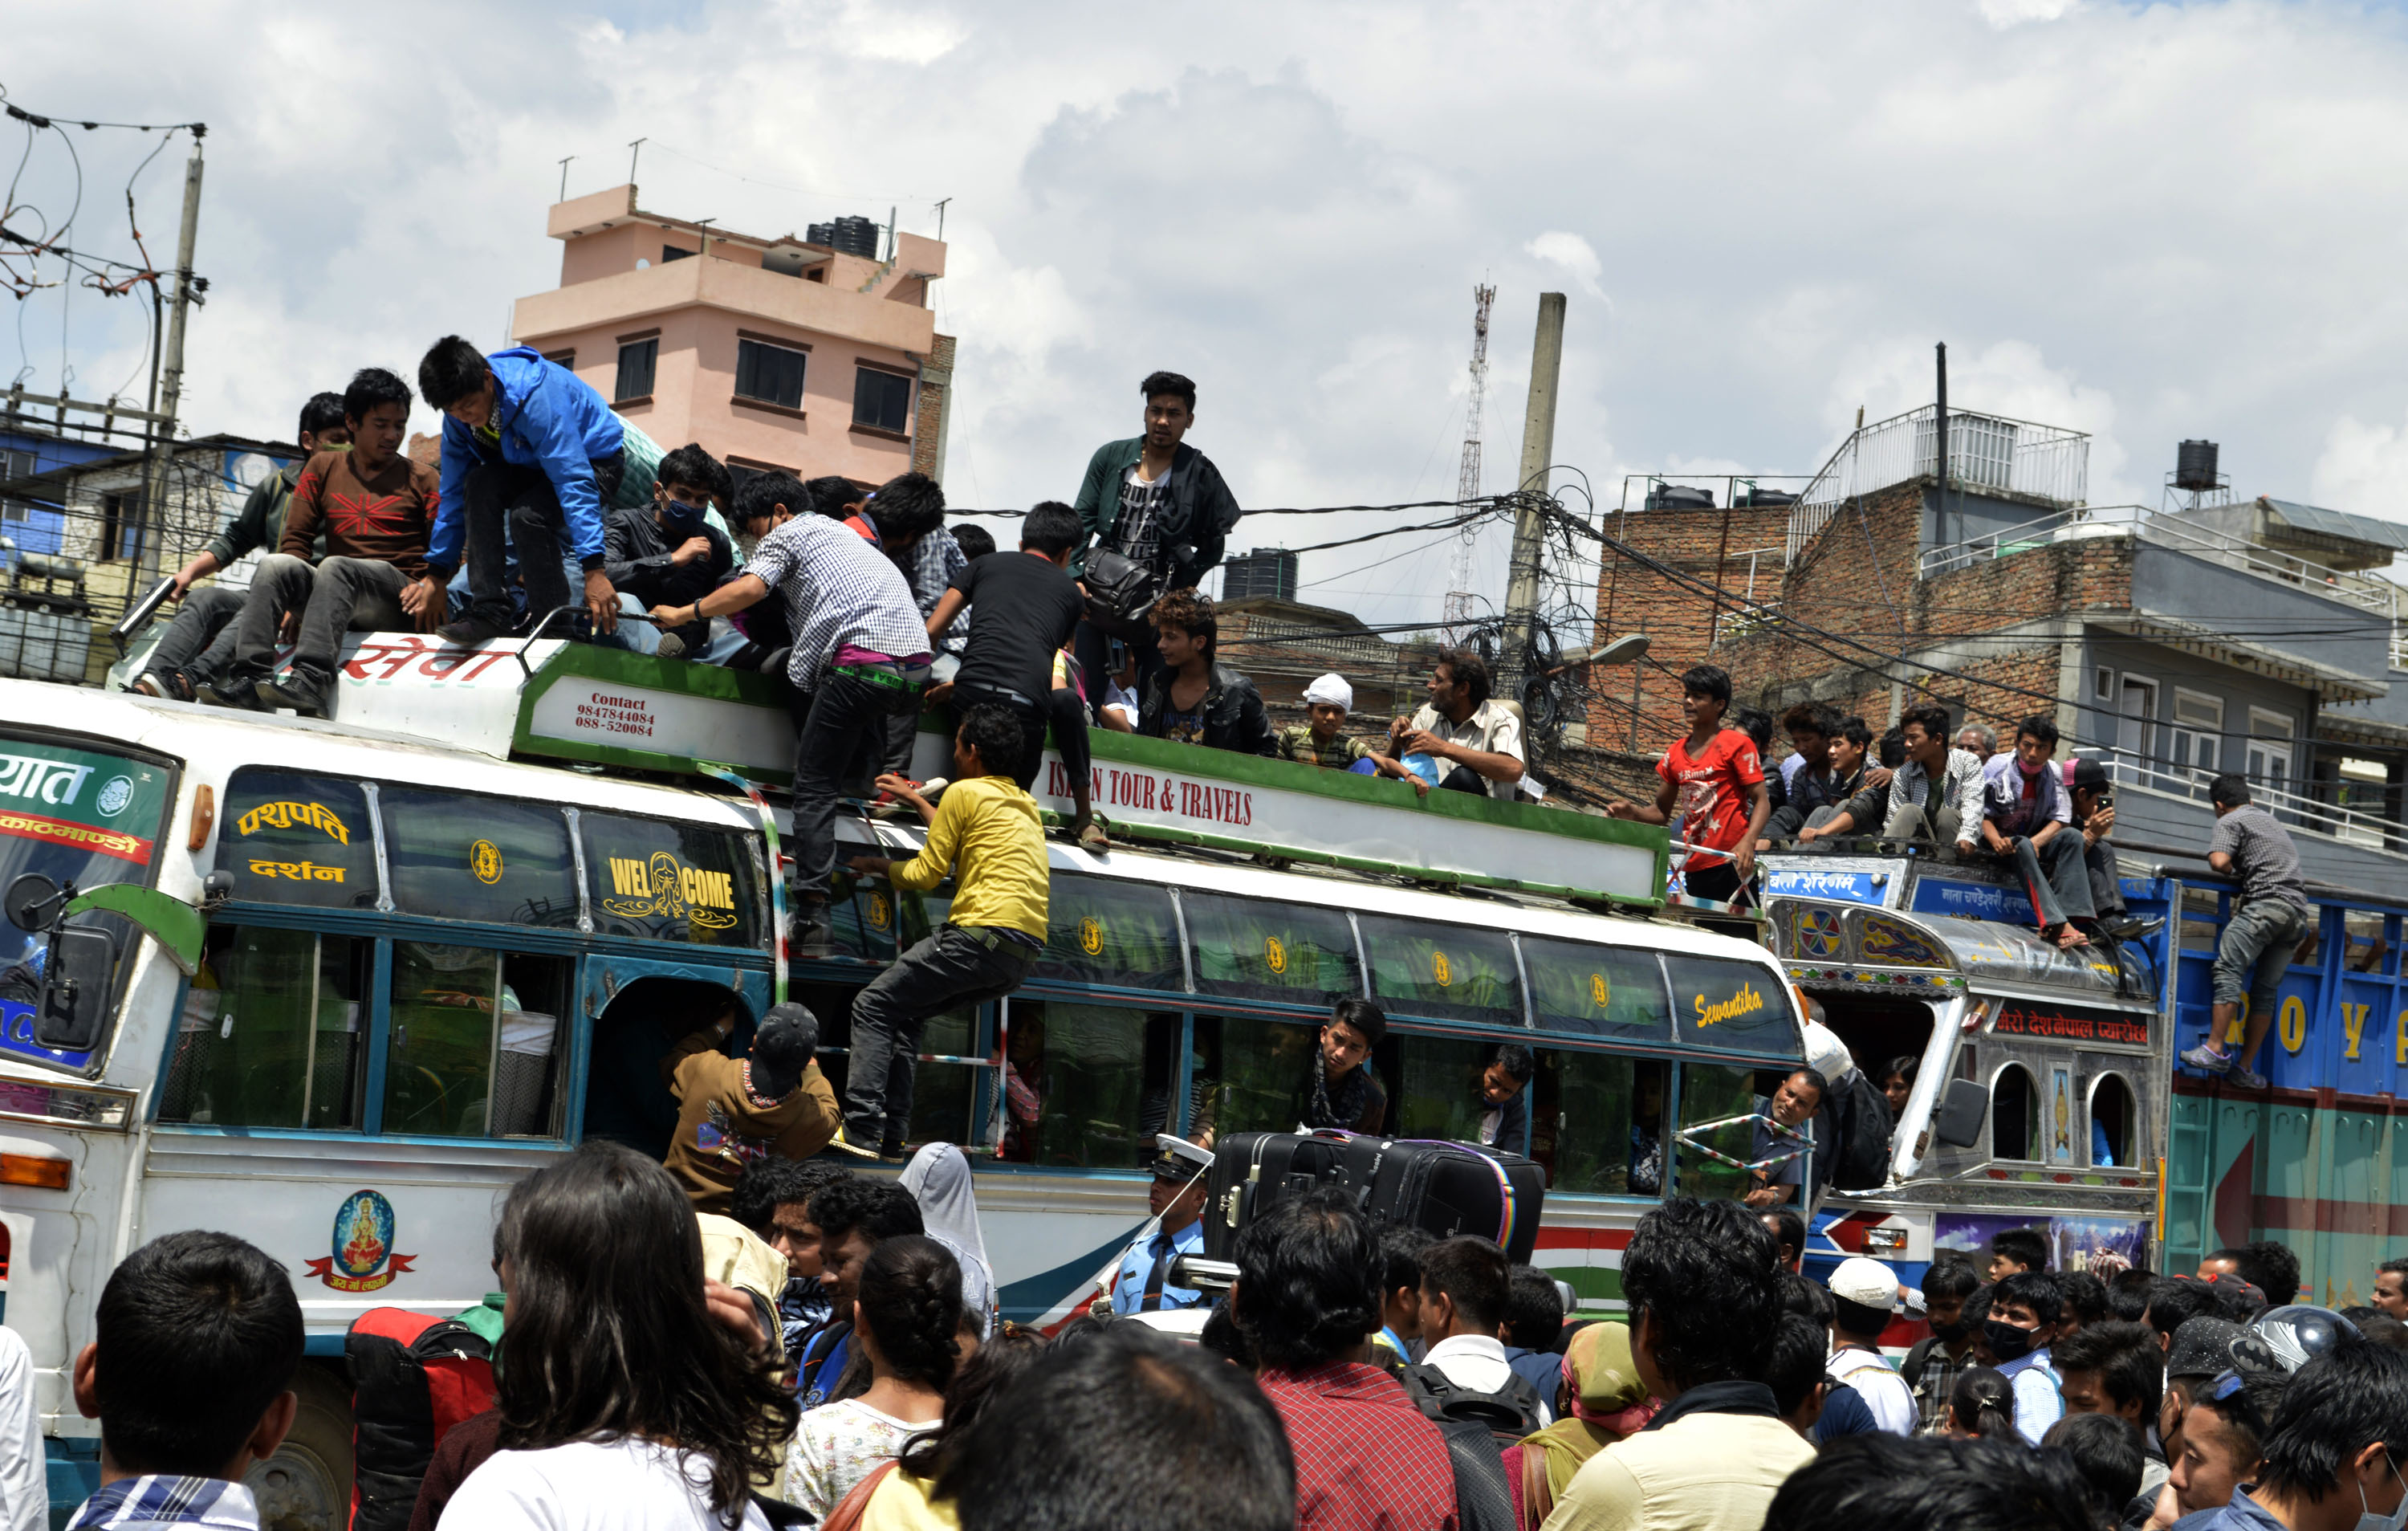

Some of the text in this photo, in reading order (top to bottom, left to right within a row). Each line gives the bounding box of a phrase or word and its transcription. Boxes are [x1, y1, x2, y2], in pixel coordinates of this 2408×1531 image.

[338, 637, 518, 688] सेवा
[592, 692, 645, 711] Contact
[576, 716, 653, 737] 088-520084
[578, 704, 655, 725] 9847844084
[1109, 769, 1155, 810] TOUR
[1160, 778, 1175, 812] &
[1180, 781, 1252, 826] TRAVELS
[237, 801, 350, 846] पशुपति
[248, 858, 347, 883] दर्शन
[1694, 982, 1763, 1028] Sewantika
[1997, 1008, 2024, 1033] मेरो
